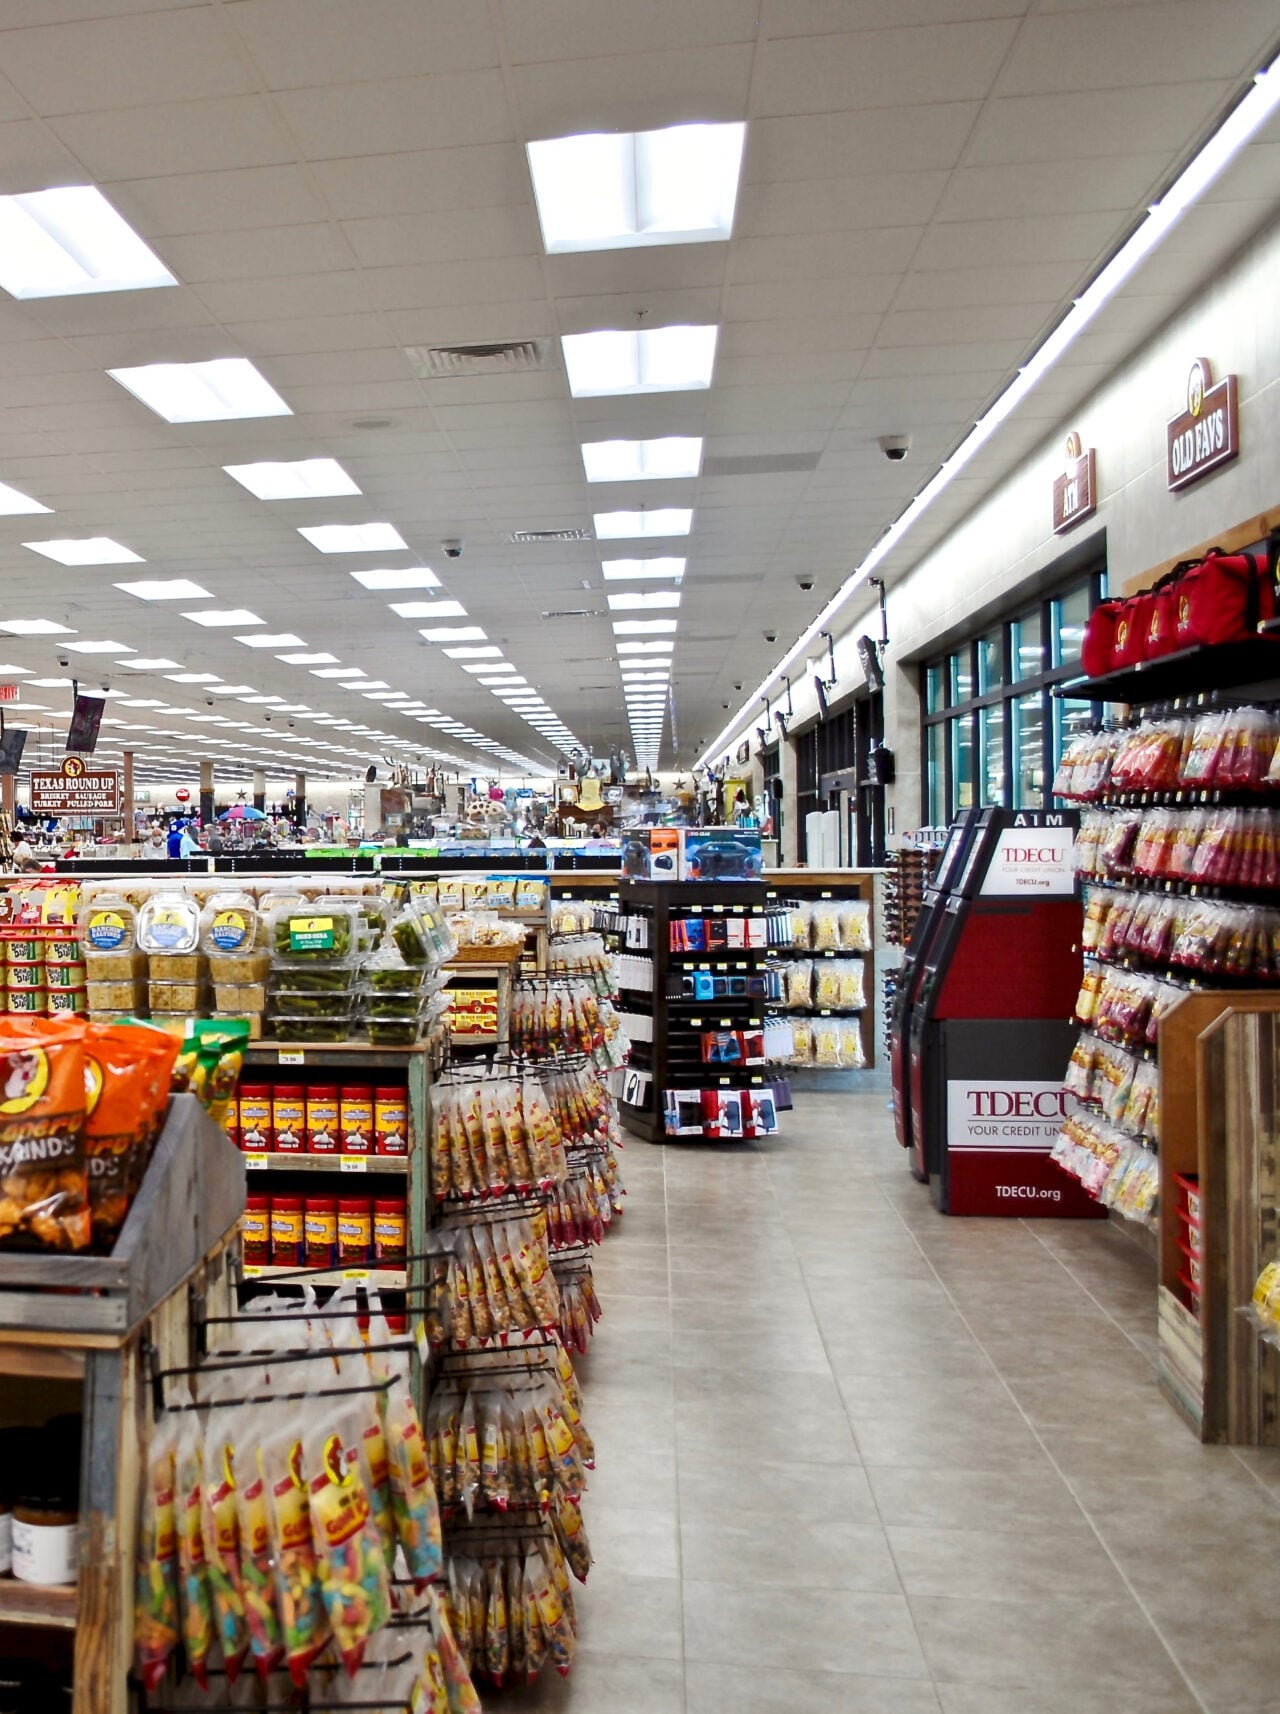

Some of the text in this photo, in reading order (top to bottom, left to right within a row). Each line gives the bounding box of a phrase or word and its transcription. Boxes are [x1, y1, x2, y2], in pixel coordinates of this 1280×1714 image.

[1173, 409, 1223, 476] OLD FAVS
[33, 778, 113, 790] TEXAS ROUND UP
[34, 800, 61, 808] TURKEY
[95, 800, 114, 808] PORK
[1014, 813, 1063, 826] ATM
[1003, 848, 1064, 863] TDECU
[968, 1126, 998, 1136] YOUR
[1002, 1126, 1040, 1136] CREDIT
[995, 1186, 1061, 1201] TDECU.org
